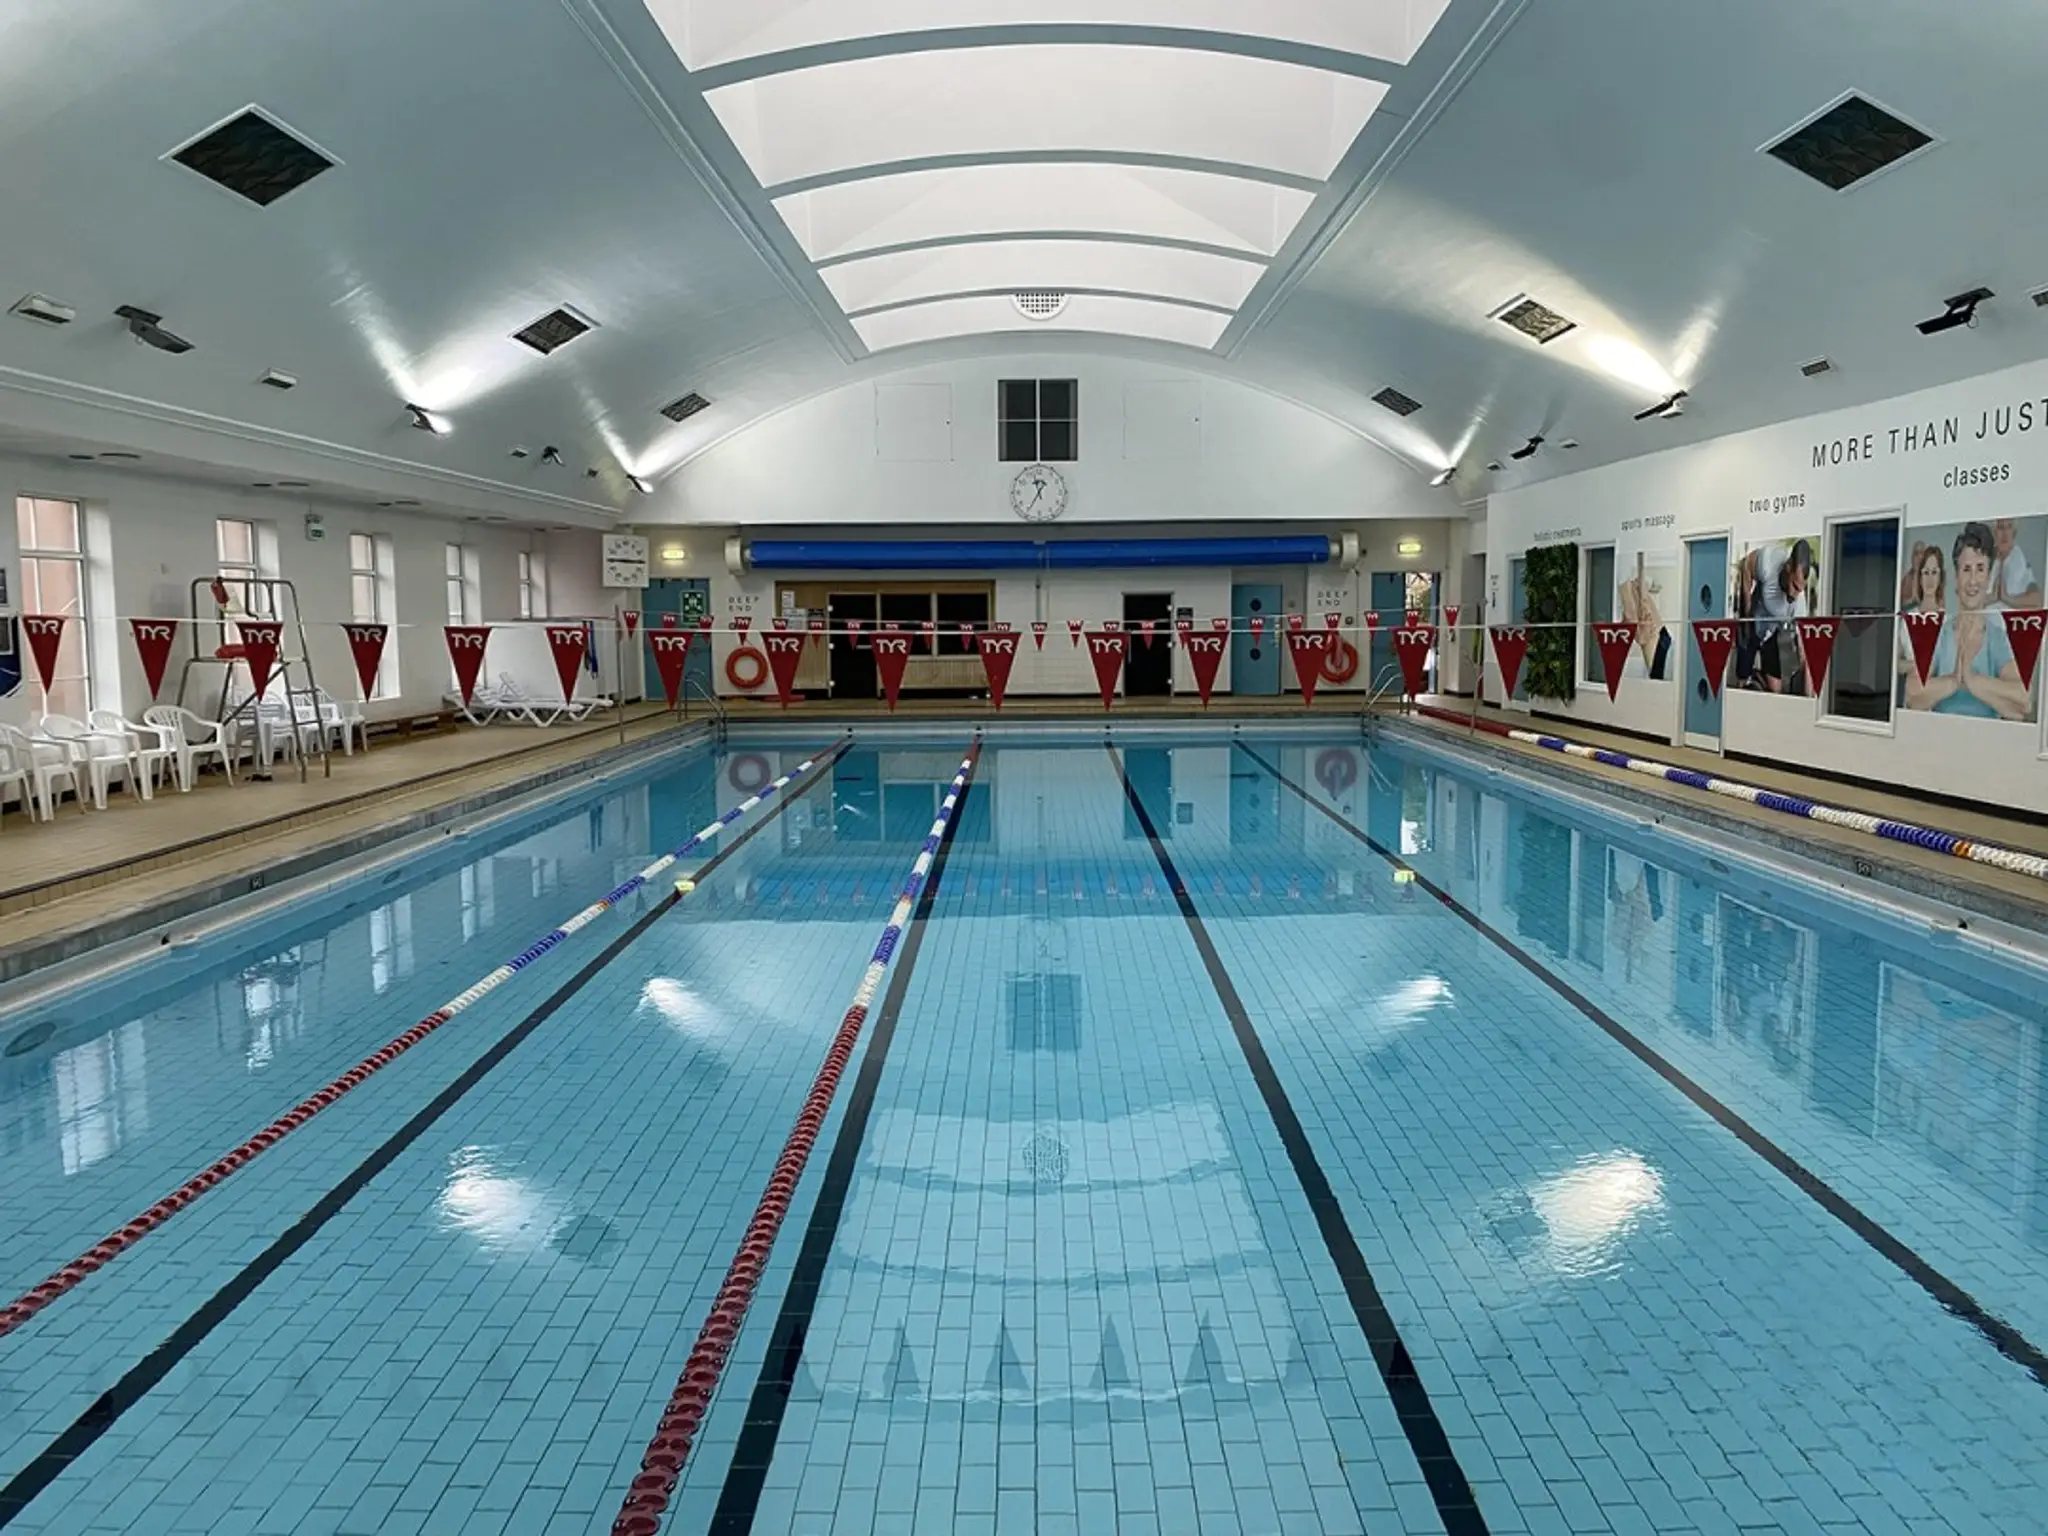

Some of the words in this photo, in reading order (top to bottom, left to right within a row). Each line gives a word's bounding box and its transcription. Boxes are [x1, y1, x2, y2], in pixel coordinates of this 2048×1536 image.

[1812, 434, 1873, 468] MORE
[1888, 417, 1958, 454] THAN
[1943, 463, 2010, 488] classes
[1749, 498, 1770, 513] two
[1773, 493, 1805, 514] gyms
[1908, 612, 1940, 626] TYR
[2009, 616, 2043, 632] TYR
[28, 619, 59, 635] TYR
[138, 625, 171, 641] TYR
[1496, 628, 1526, 641] TYR
[1700, 627, 1731, 642] TYR
[1803, 623, 1833, 639] TYR
[244, 629, 276, 644] TYR
[351, 627, 383, 643] TYR
[452, 633, 483, 649] TYR
[552, 630, 584, 645] TYR
[1292, 635, 1324, 650] TYR
[1397, 631, 1429, 645] TYR
[1600, 629, 1631, 644] TYR
[654, 636, 687, 652] TYR
[768, 637, 800, 652] TYR
[876, 639, 906, 654] TYR
[983, 639, 1014, 654] TYR
[1092, 638, 1123, 653] TYR
[1191, 637, 1221, 652] TYR
